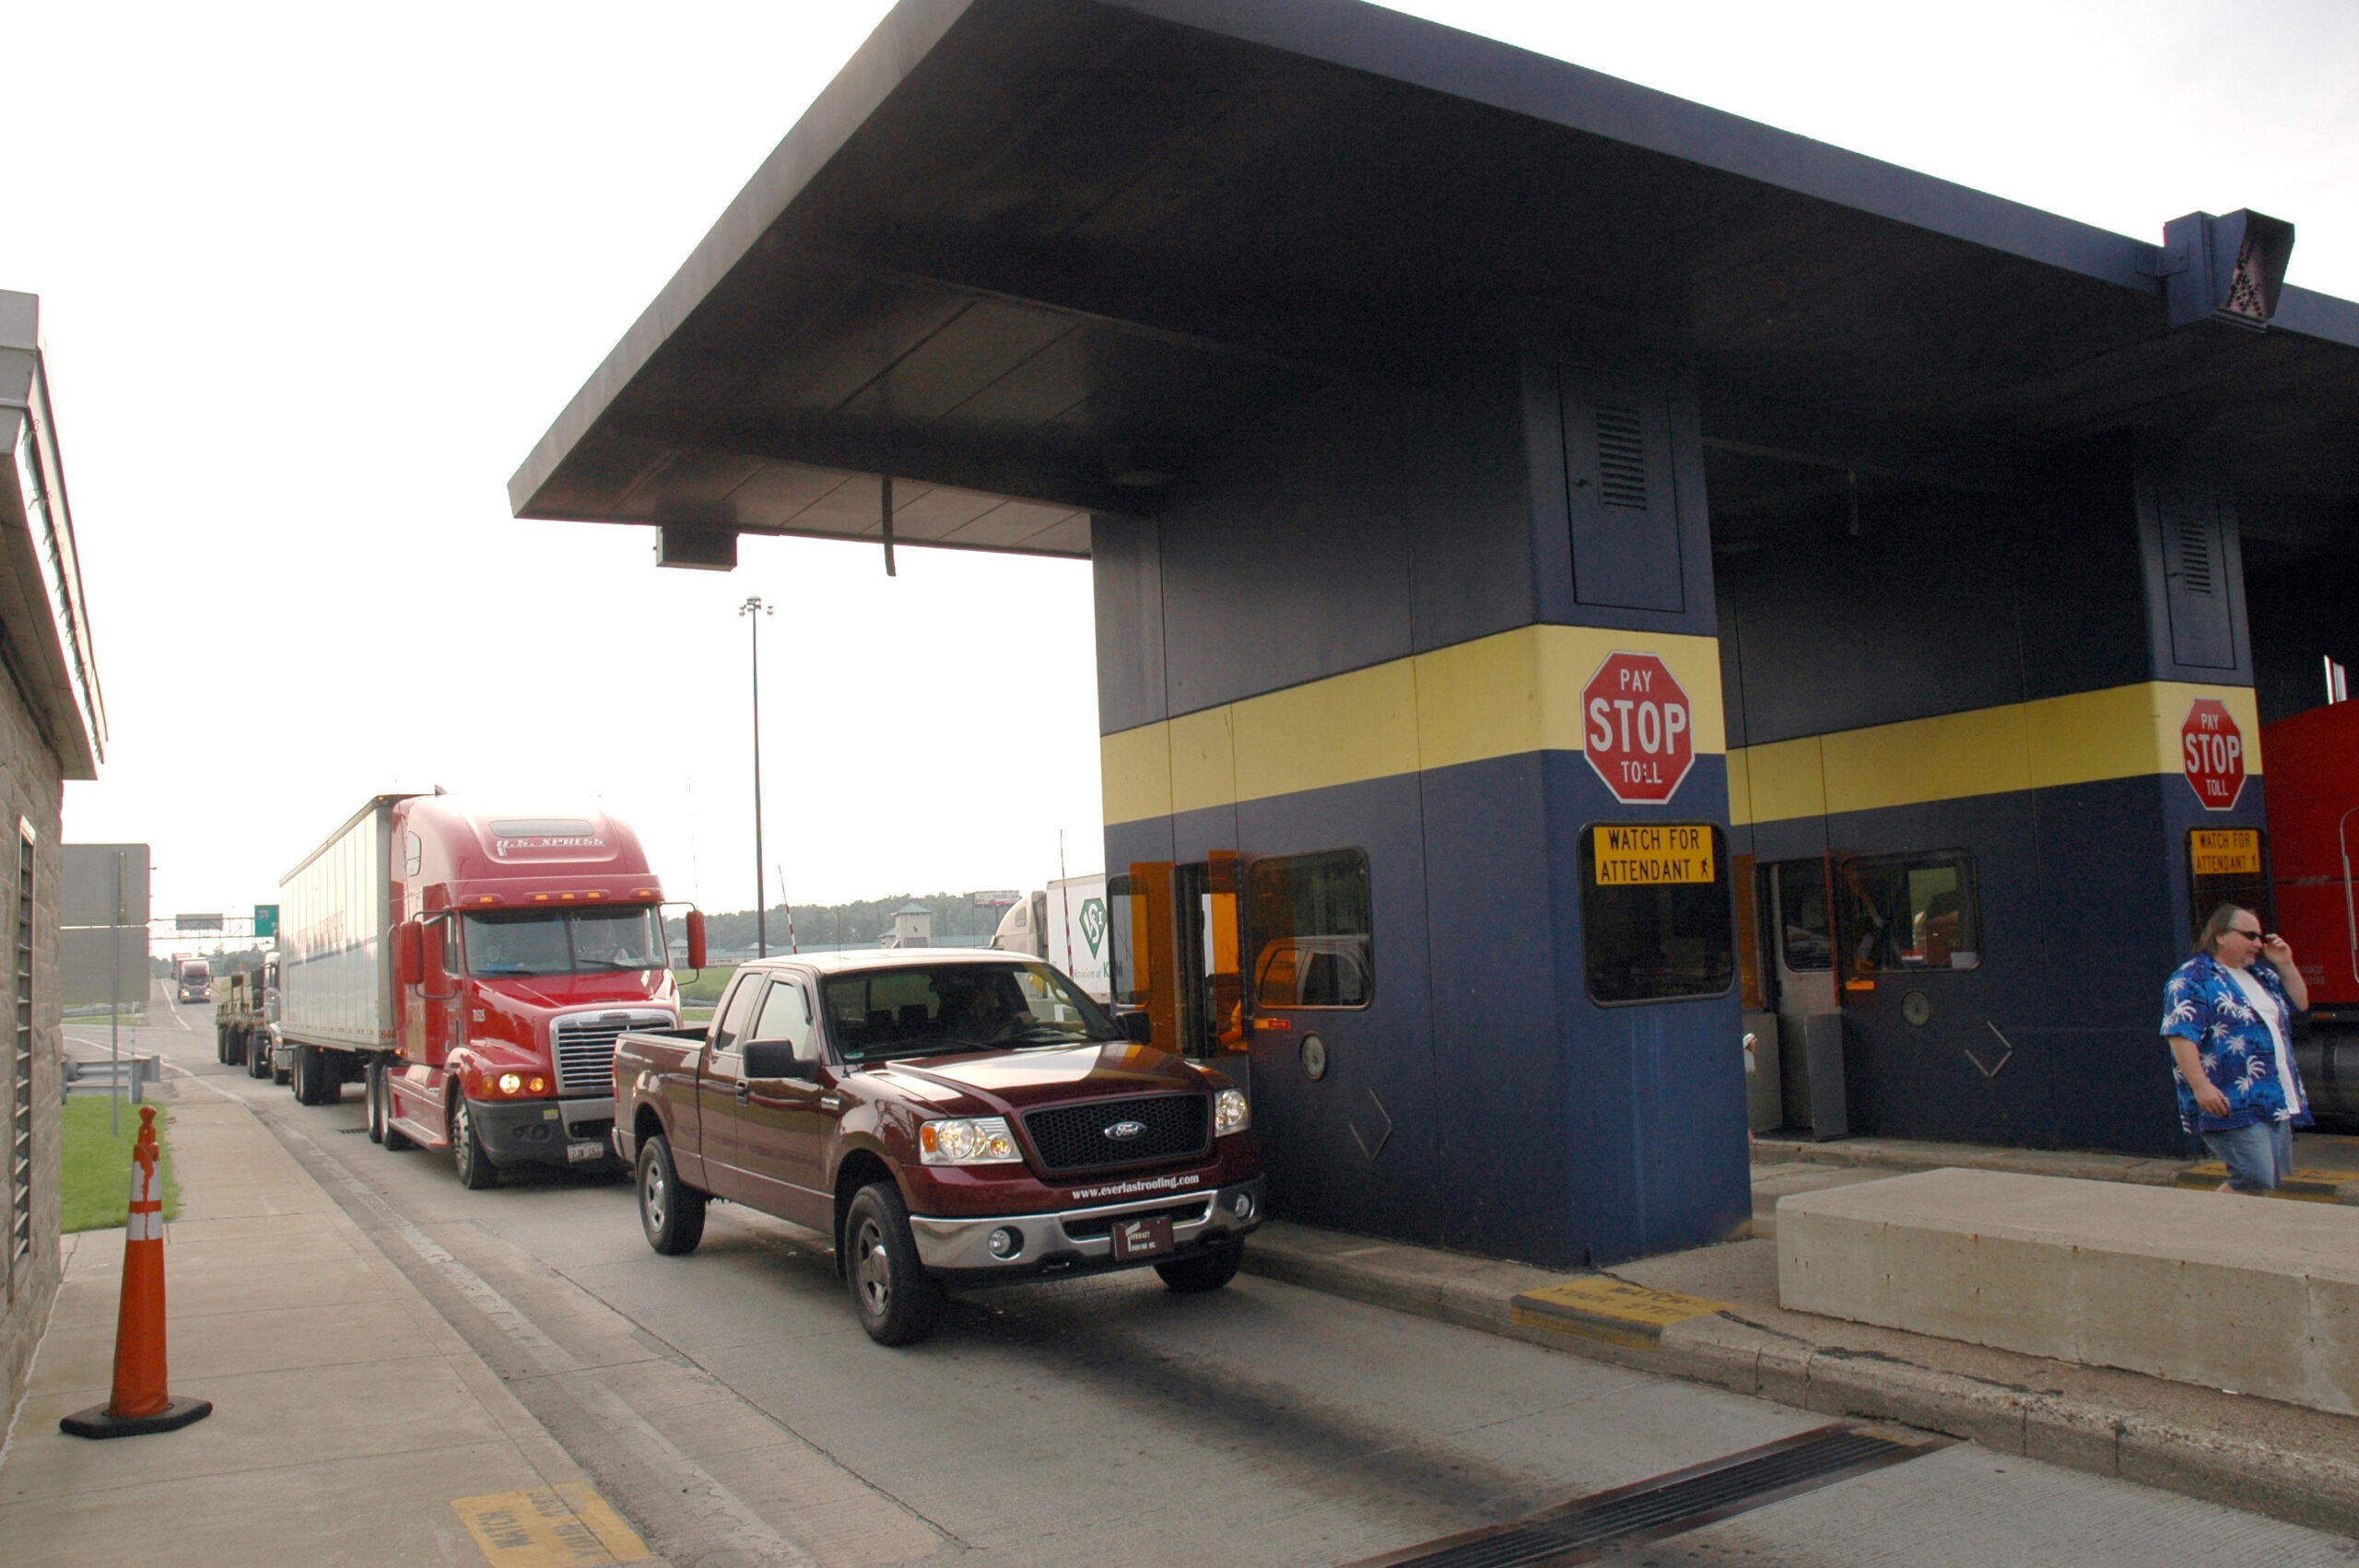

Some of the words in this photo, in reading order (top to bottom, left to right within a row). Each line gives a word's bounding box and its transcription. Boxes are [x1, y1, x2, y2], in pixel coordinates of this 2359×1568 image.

[1620, 669, 1652, 692] PAY
[1590, 697, 1686, 755] STOP
[2201, 713, 2219, 730] PAY
[2185, 732, 2240, 775] STOP
[2205, 779, 2229, 796] TOLL
[542, 837, 605, 848] XPRESS
[1608, 829, 1661, 850] WATCH
[1670, 829, 1700, 850] FOR
[2199, 833, 2228, 849] WATCH
[2234, 833, 2251, 848] FOR
[1601, 859, 1691, 883] ATTENDANT
[2197, 855, 2247, 873] ATTENDANT
[1115, 1123, 1140, 1137] Ford
[1072, 1175, 1200, 1199] www.everlastroofing.com
